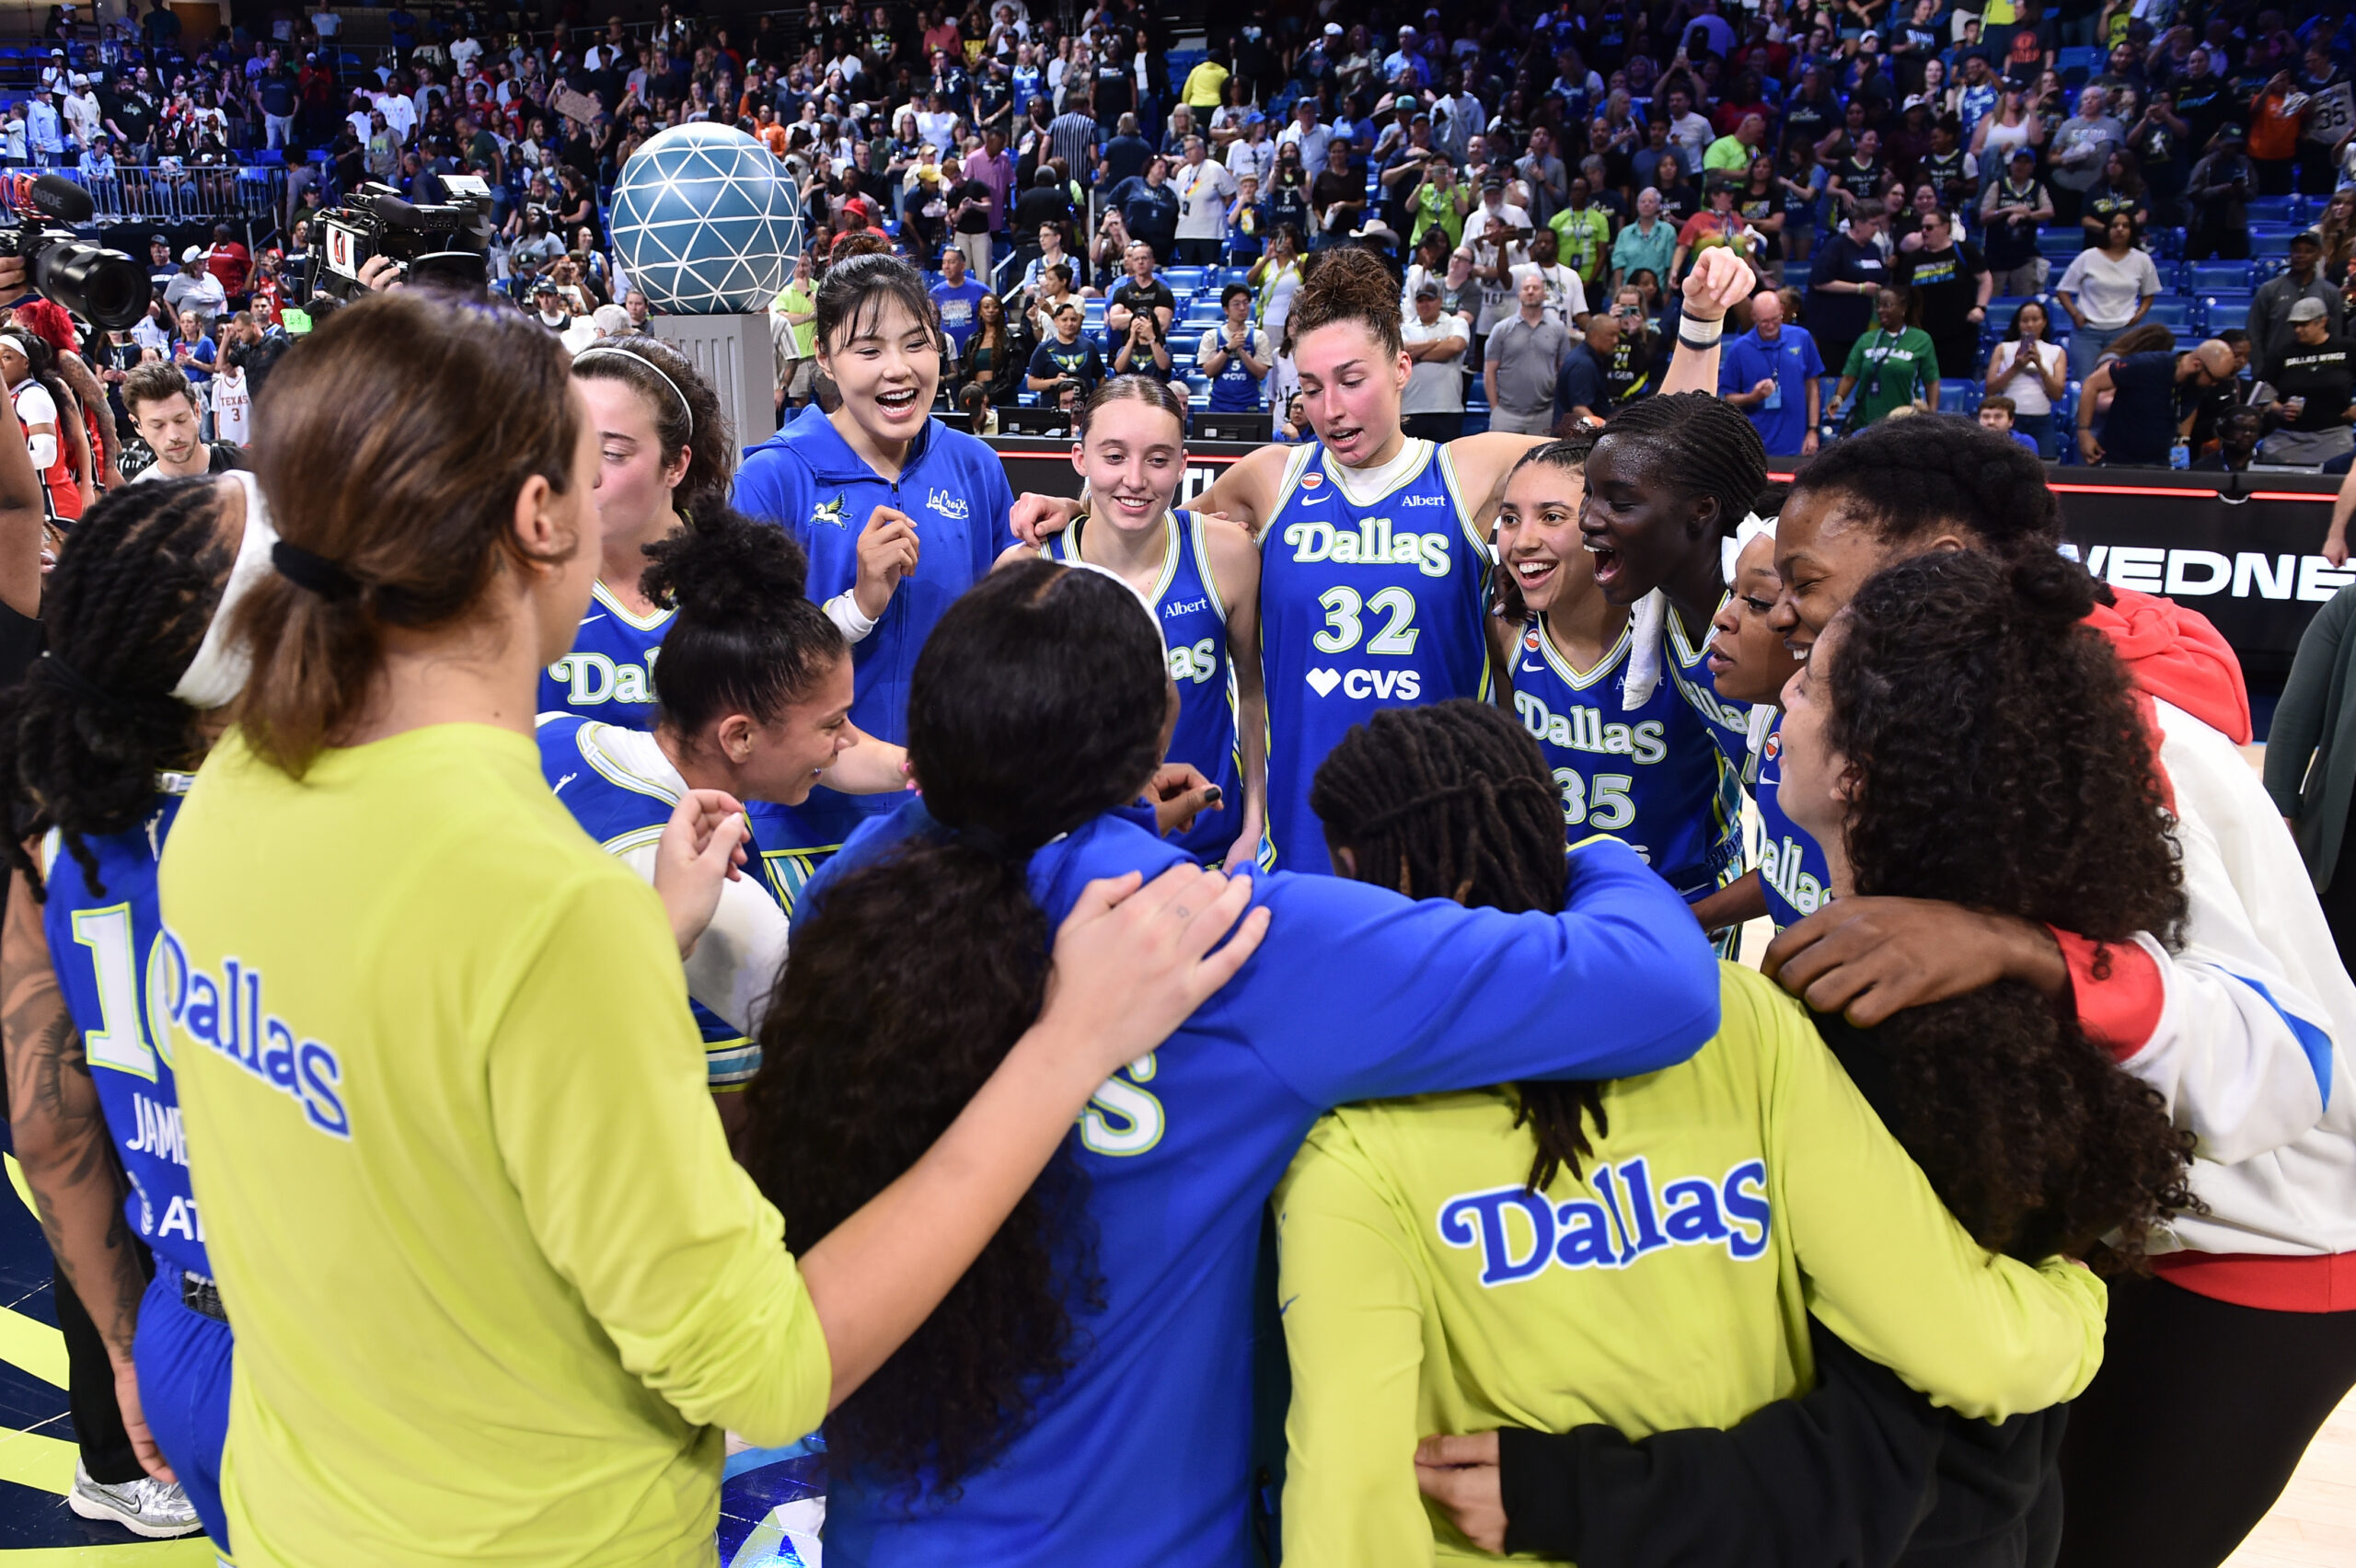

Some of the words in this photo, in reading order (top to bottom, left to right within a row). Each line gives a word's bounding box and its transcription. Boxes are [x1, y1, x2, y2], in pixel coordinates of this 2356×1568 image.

[1231, 360, 1241, 371] 5
[2284, 355, 2317, 366] DALLAS
[2319, 352, 2346, 362] WINGS
[1230, 373, 1247, 381] CVS
[220, 395, 248, 407] TEXAS
[232, 408, 240, 421] 3
[926, 487, 969, 519] LaCroix
[1402, 494, 1446, 507] Albert
[1284, 516, 1451, 577] Dallas
[1164, 597, 1207, 619] Albert
[1312, 585, 1420, 655] 32
[1343, 668, 1421, 700] CVS
[1514, 690, 1667, 765] Dallas
[1553, 767, 1635, 829] 35
[1437, 1155, 1772, 1287] Dallas
